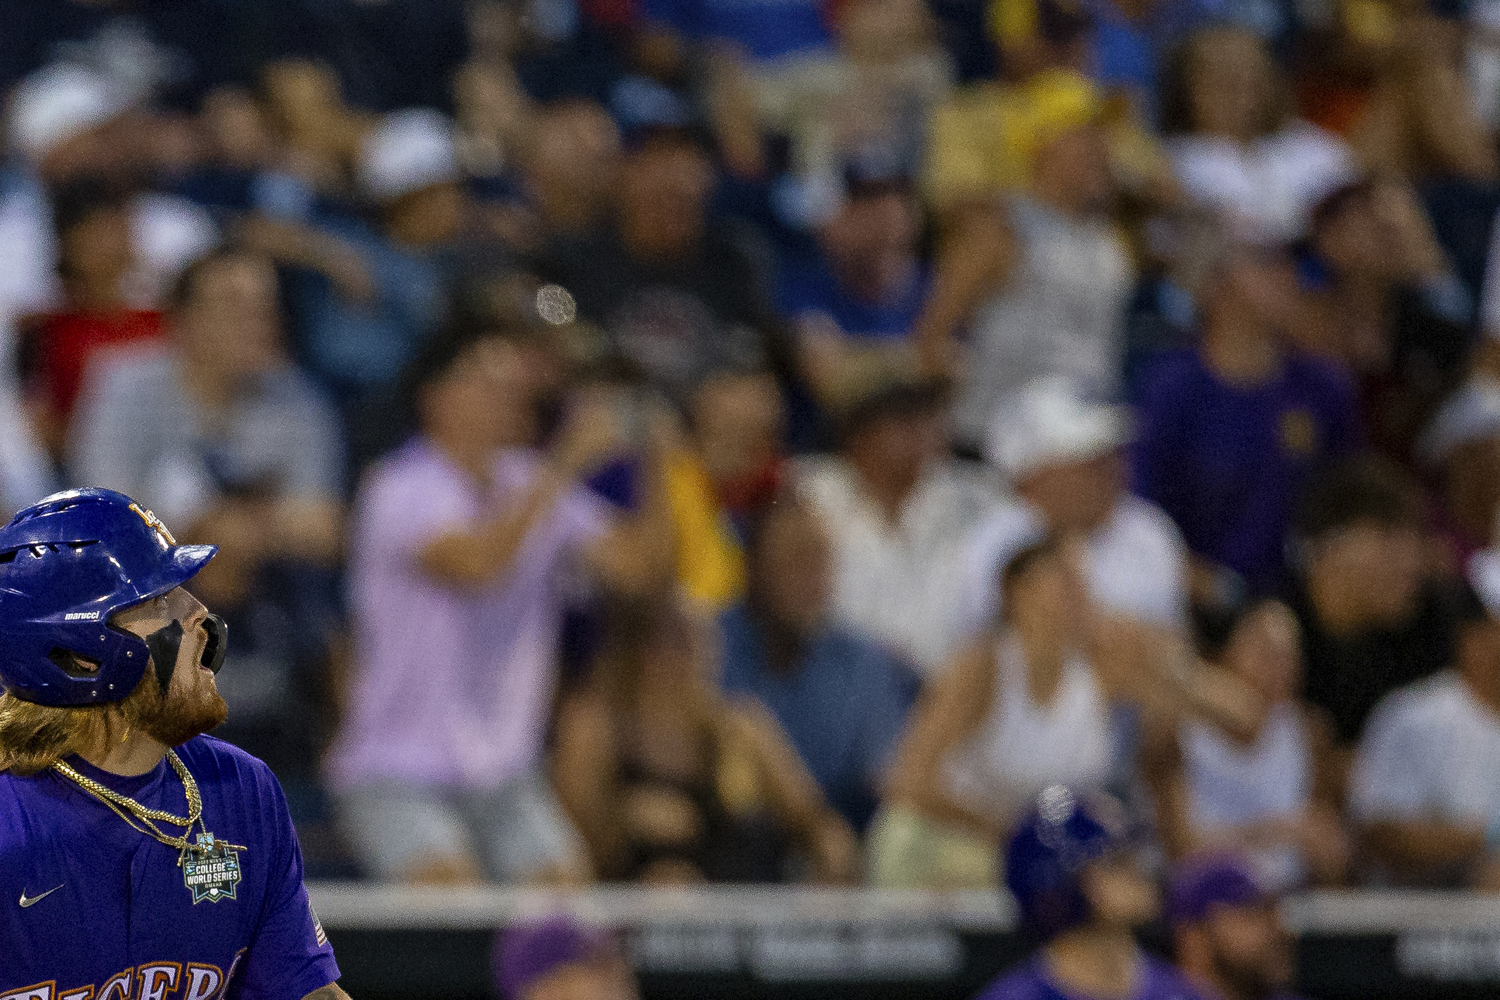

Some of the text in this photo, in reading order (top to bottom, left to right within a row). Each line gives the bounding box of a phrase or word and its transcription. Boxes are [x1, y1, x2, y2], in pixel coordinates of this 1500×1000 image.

[64, 610, 100, 621] marucci
[196, 862, 226, 875] COLLEGE
[187, 871, 238, 885] WORLD SERIES
